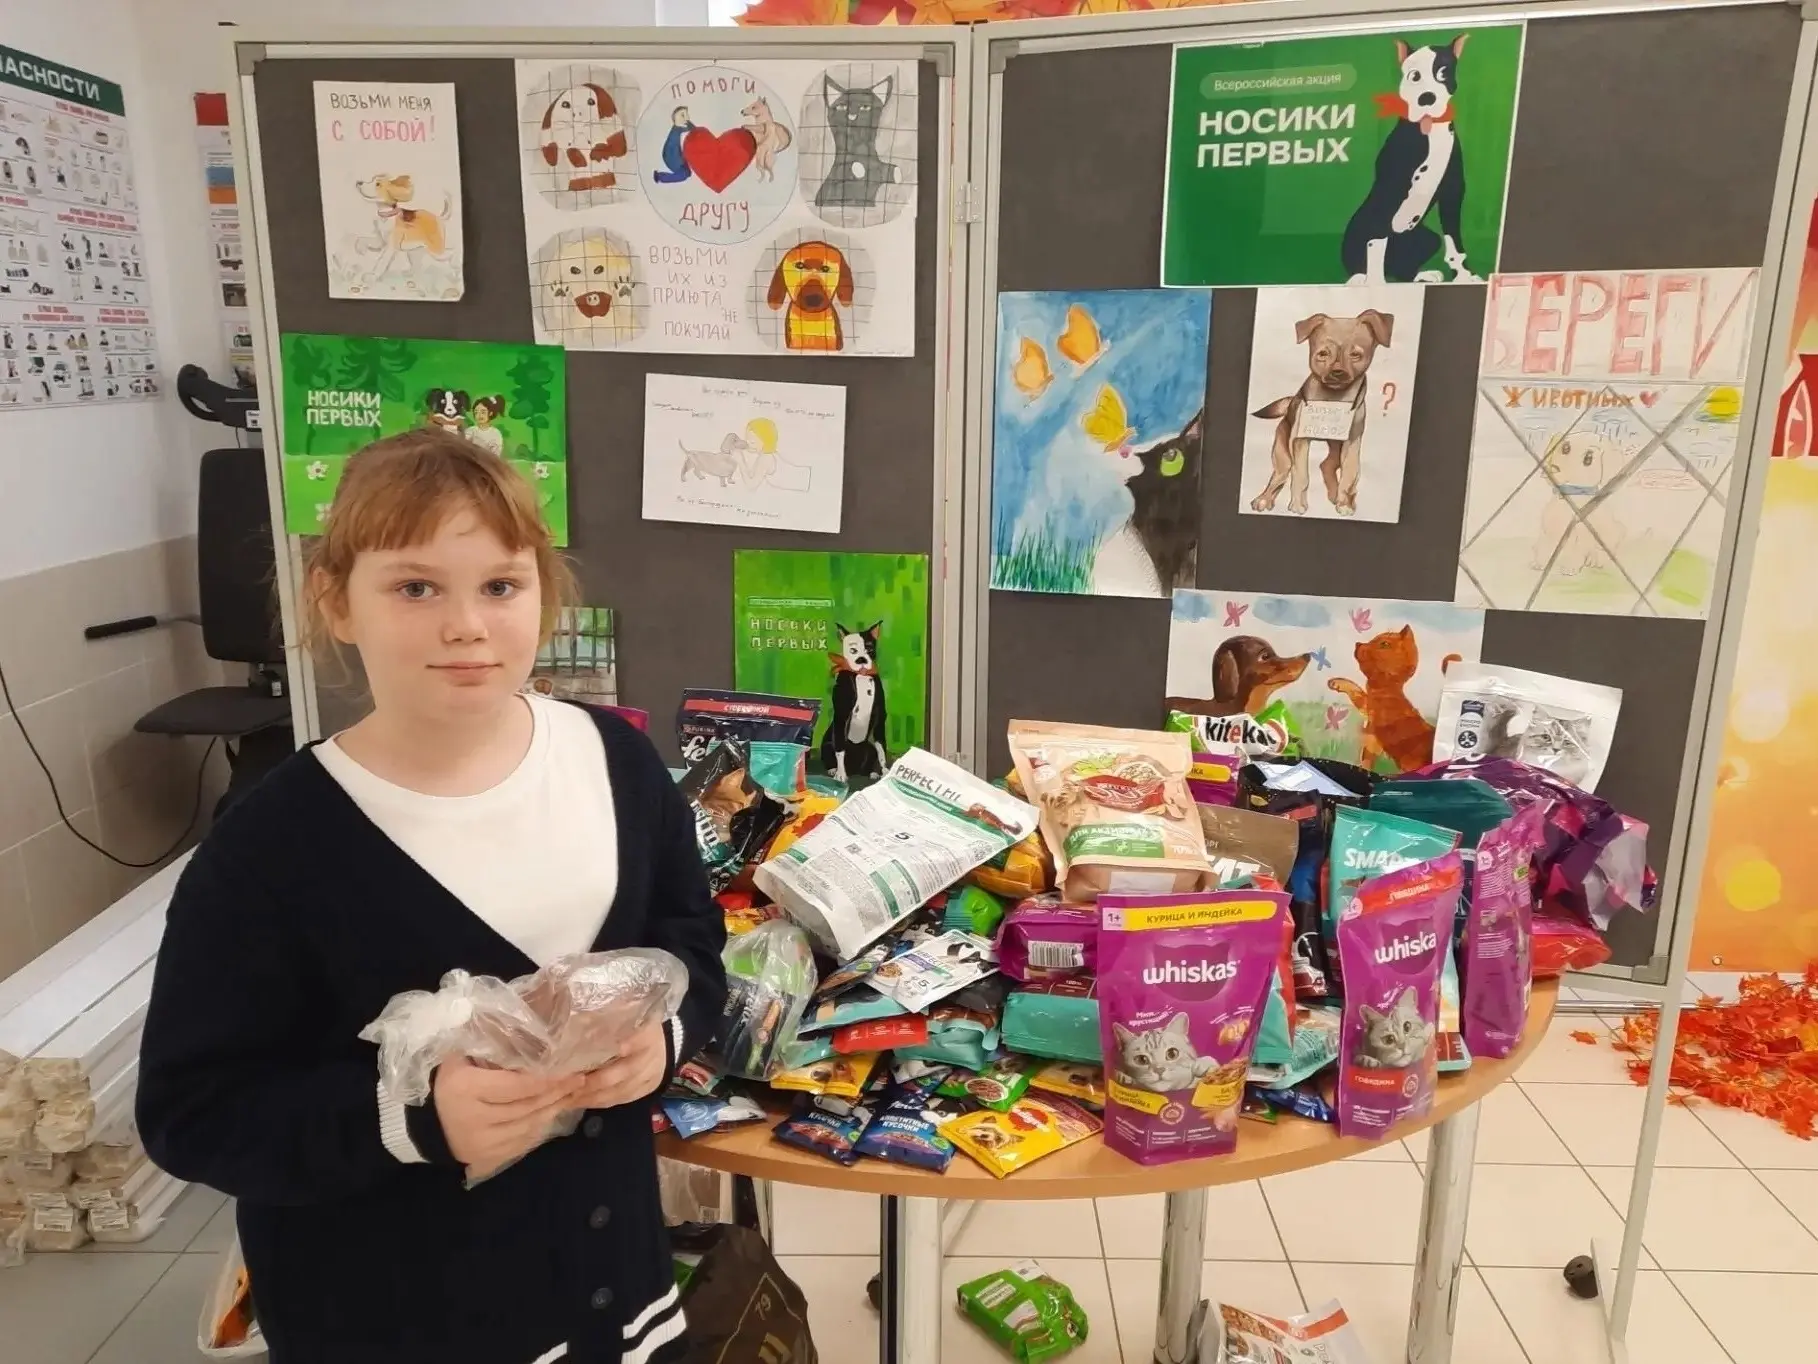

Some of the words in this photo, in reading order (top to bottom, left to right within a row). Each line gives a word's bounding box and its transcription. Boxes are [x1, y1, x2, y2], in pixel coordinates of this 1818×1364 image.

[0, 53, 100, 101] АСНОСТИ
[671, 76, 757, 99] ПОМОГИ
[1214, 76, 1303, 92] Всероссийская
[1307, 72, 1342, 86] акция
[330, 93, 392, 110] ВОЗЬМИ
[399, 95, 432, 111] МЕНЯ
[332, 119, 344, 141] С
[360, 115, 436, 142] СОБОЙ!
[1199, 103, 1356, 136] НОСИКИ
[1197, 137, 1352, 168] ПЕРВЫХ
[678, 201, 750, 233] ДРУГУ
[649, 245, 728, 267] ВОЗЬМИ
[653, 287, 722, 307] ПРИЮТА
[664, 320, 731, 340] ПОКУПАЙ
[1484, 268, 1758, 379] БЕРЕГИ
[307, 389, 381, 409] НОСИКИ
[306, 408, 382, 428] ПЕРВЫХ
[751, 618, 827, 632] НОСИКИ
[752, 637, 828, 650] ПЕРВЫХ
[1343, 847, 1402, 870] SMA
[1146, 914, 1185, 924] КУРИЦА
[1188, 911, 1195, 920] И
[1197, 908, 1243, 919] ИНДЕЙКА
[1374, 931, 1437, 964] whiska
[1143, 960, 1237, 985] whiskas
[882, 1121, 919, 1133] КУСОЧКИ
